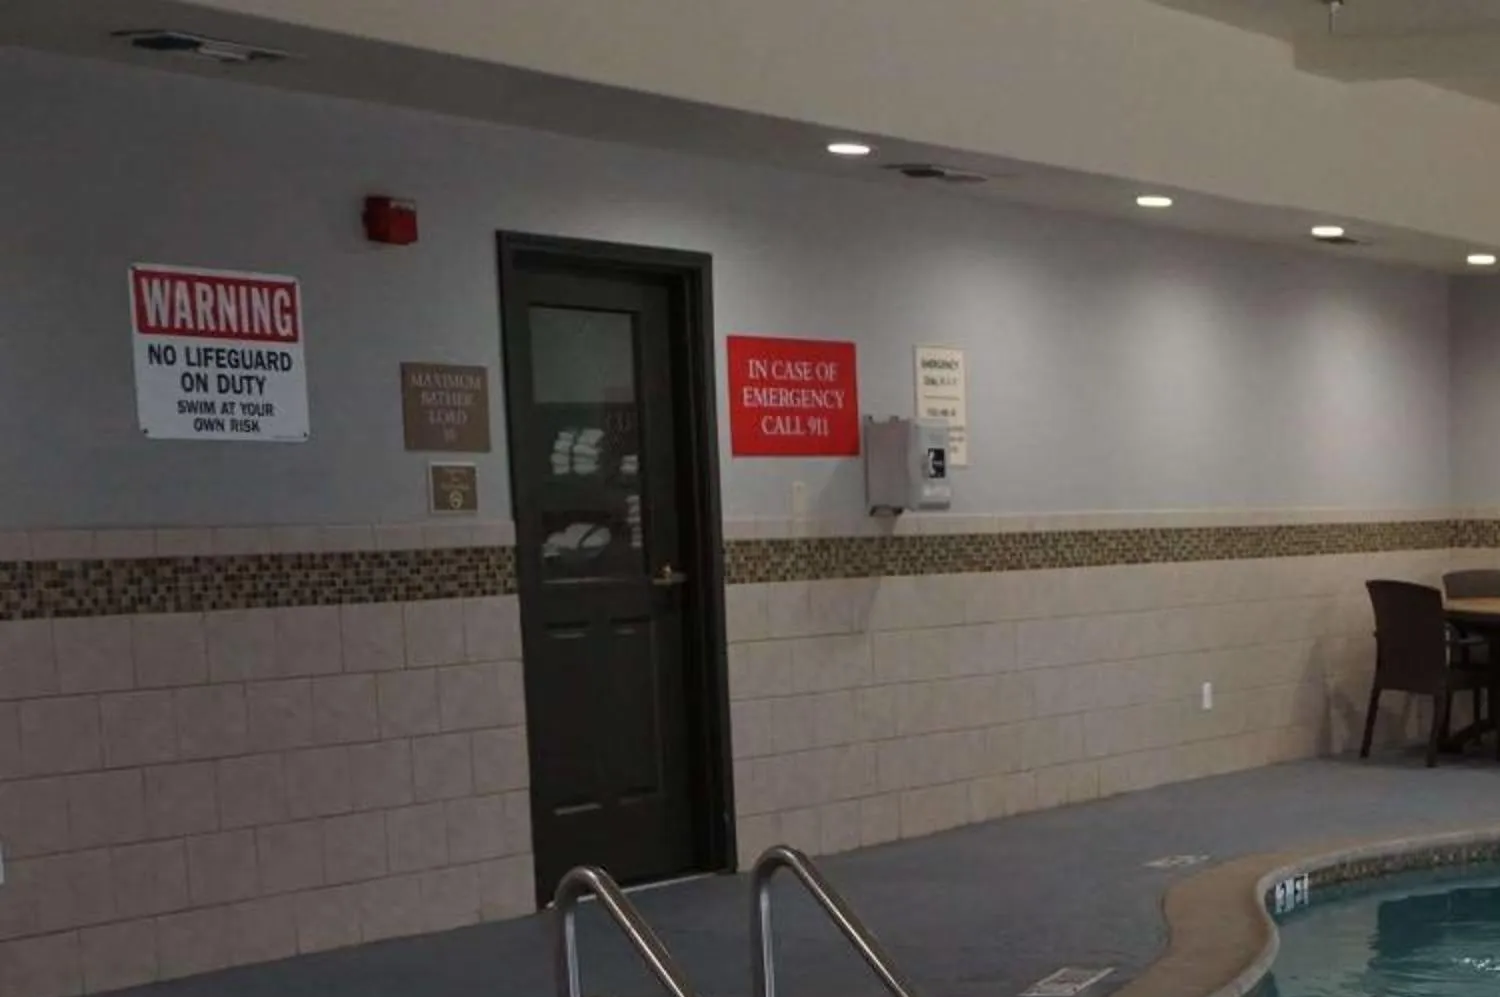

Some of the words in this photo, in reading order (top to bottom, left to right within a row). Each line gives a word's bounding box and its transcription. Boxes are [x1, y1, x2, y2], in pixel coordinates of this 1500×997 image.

[140, 277, 294, 337] WARNING
[148, 344, 176, 366] NO
[185, 346, 292, 371] LIFEGUARD
[748, 359, 768, 379] IN
[771, 360, 813, 381] CASE
[816, 362, 838, 383] OF
[180, 372, 209, 393] ON
[217, 375, 267, 395] DUTY
[177, 400, 216, 414] SWIM
[220, 401, 236, 415] AT
[240, 402, 274, 416] YOUR
[742, 387, 845, 410] EMERGENCY
[193, 418, 225, 432] OWN
[230, 419, 260, 433] RISK
[761, 416, 805, 436] CALL
[809, 417, 829, 437] 911
